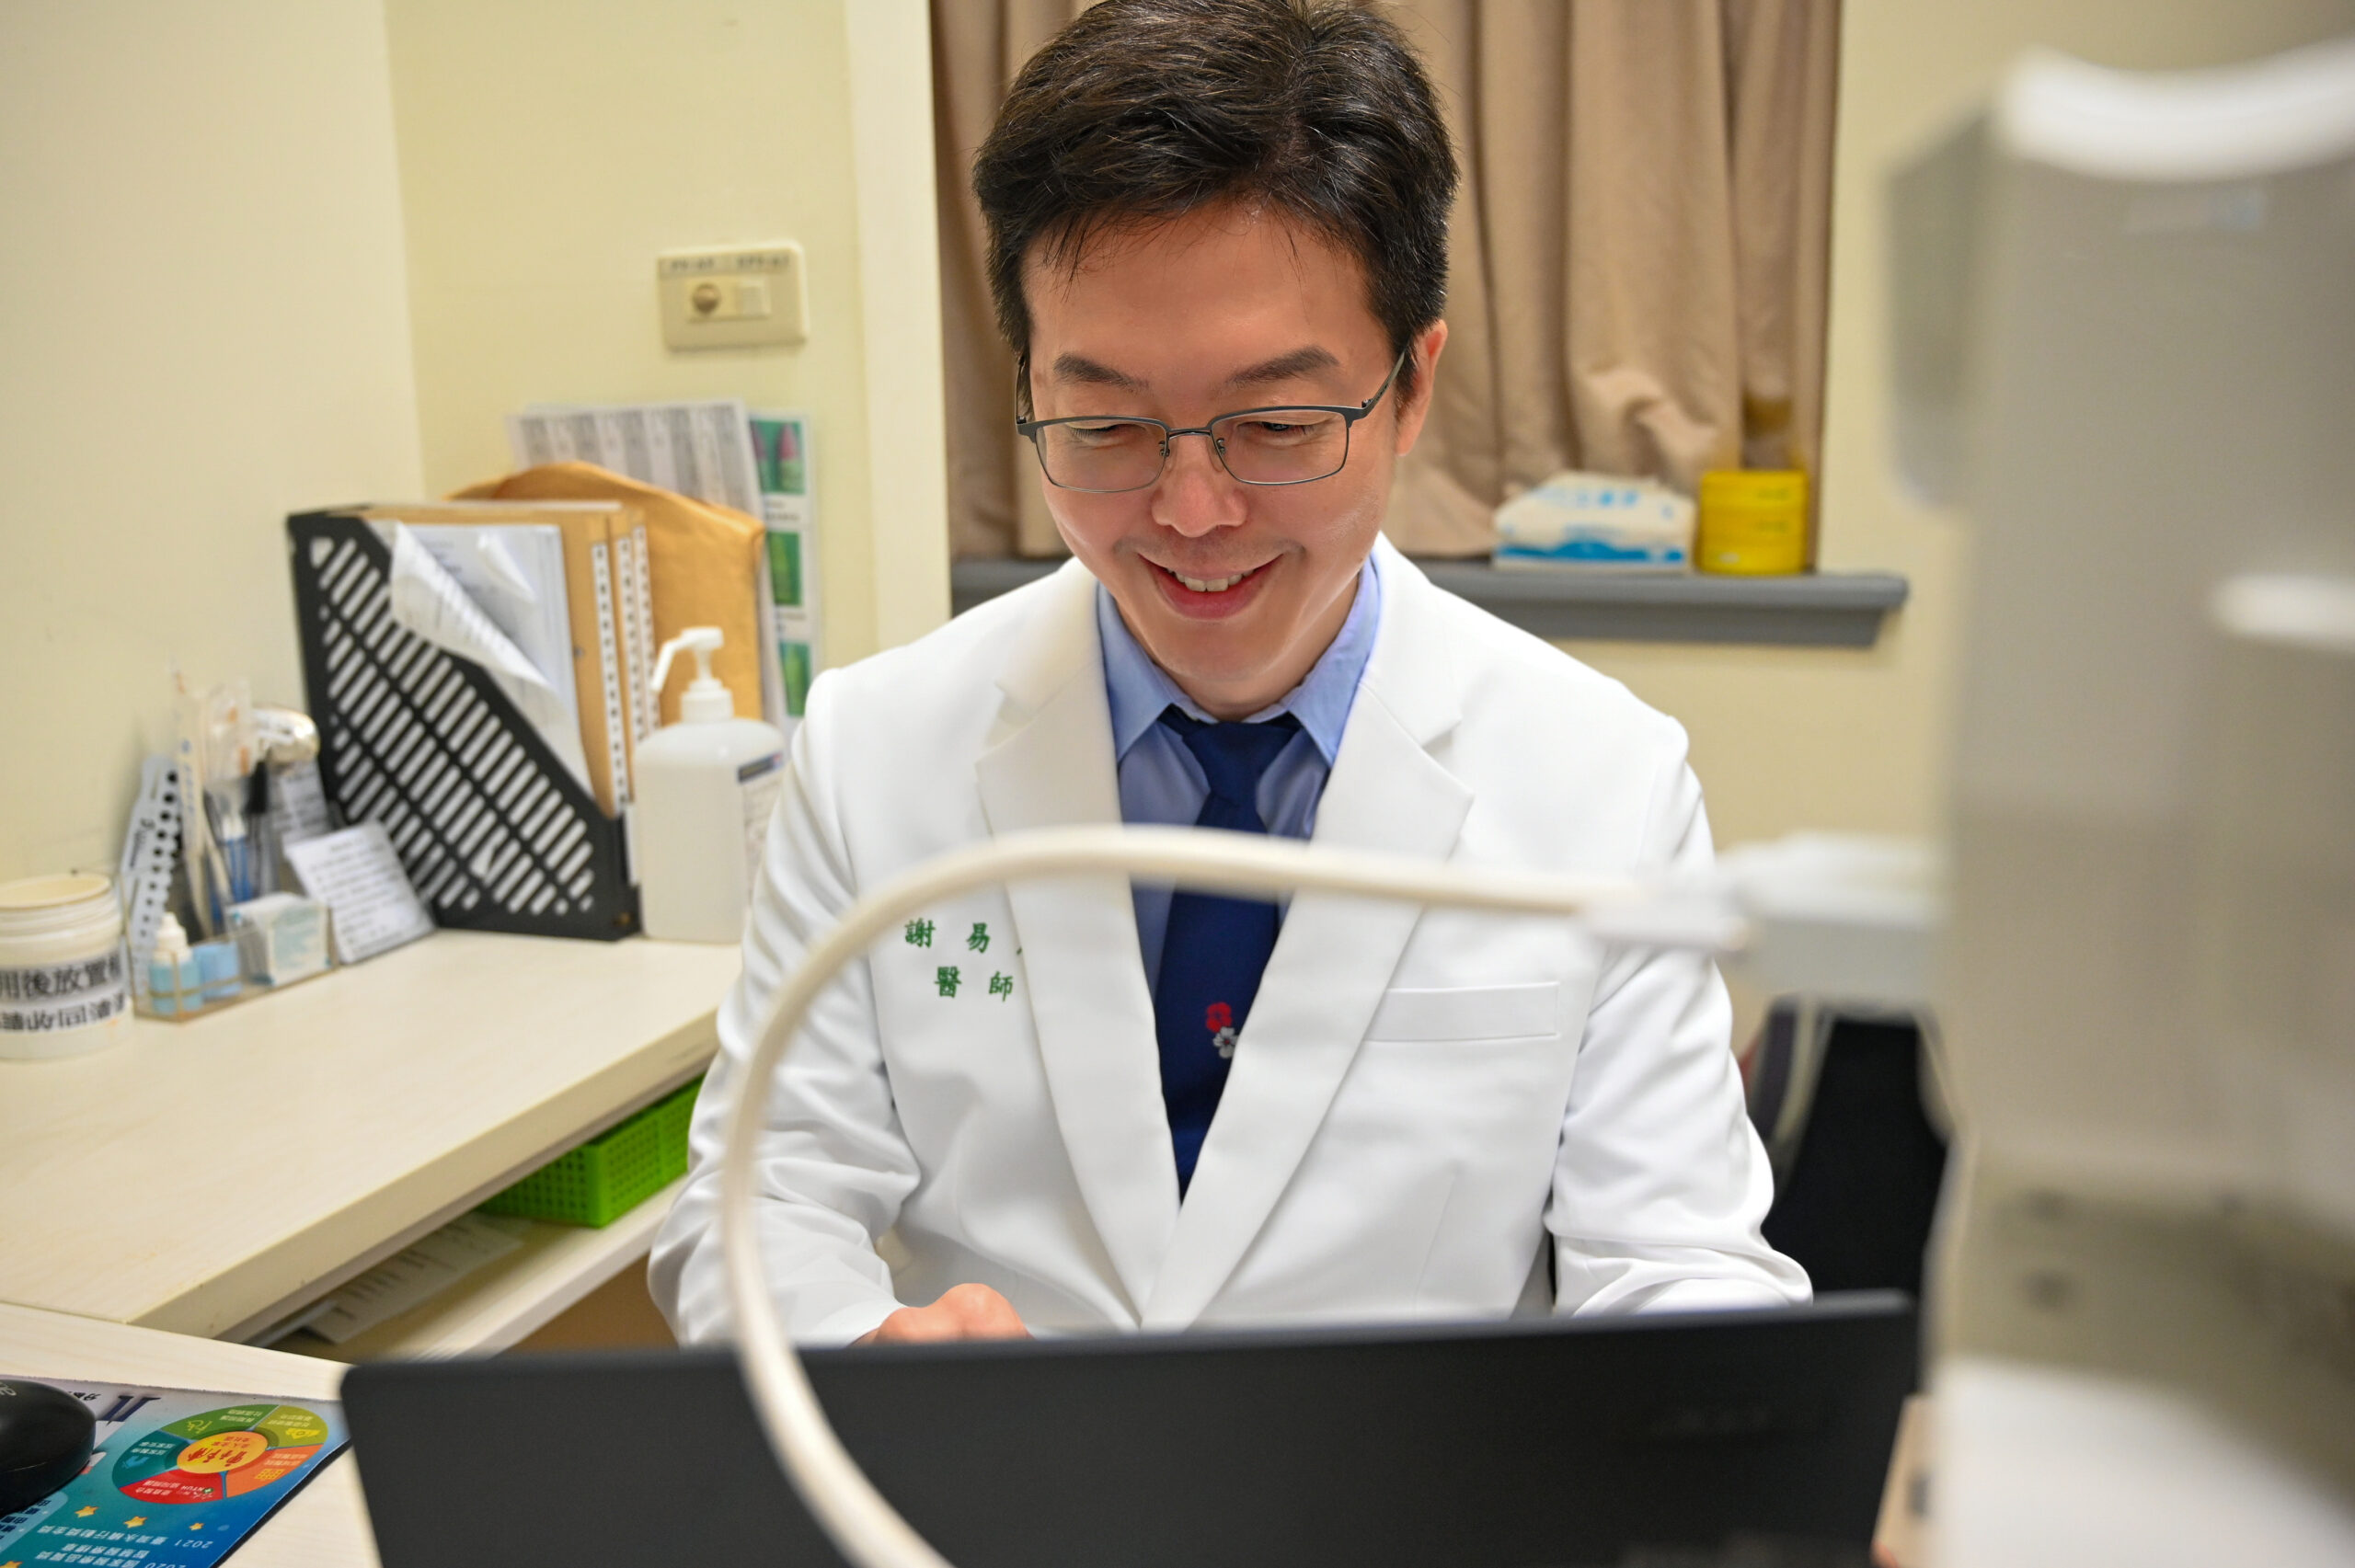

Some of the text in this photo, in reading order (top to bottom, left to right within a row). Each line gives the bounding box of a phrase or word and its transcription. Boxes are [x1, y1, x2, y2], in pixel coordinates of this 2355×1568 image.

[904, 917, 1023, 956] 謝易
[934, 966, 1014, 1002] 醫師
[174, 1539, 213, 1549] 2021
